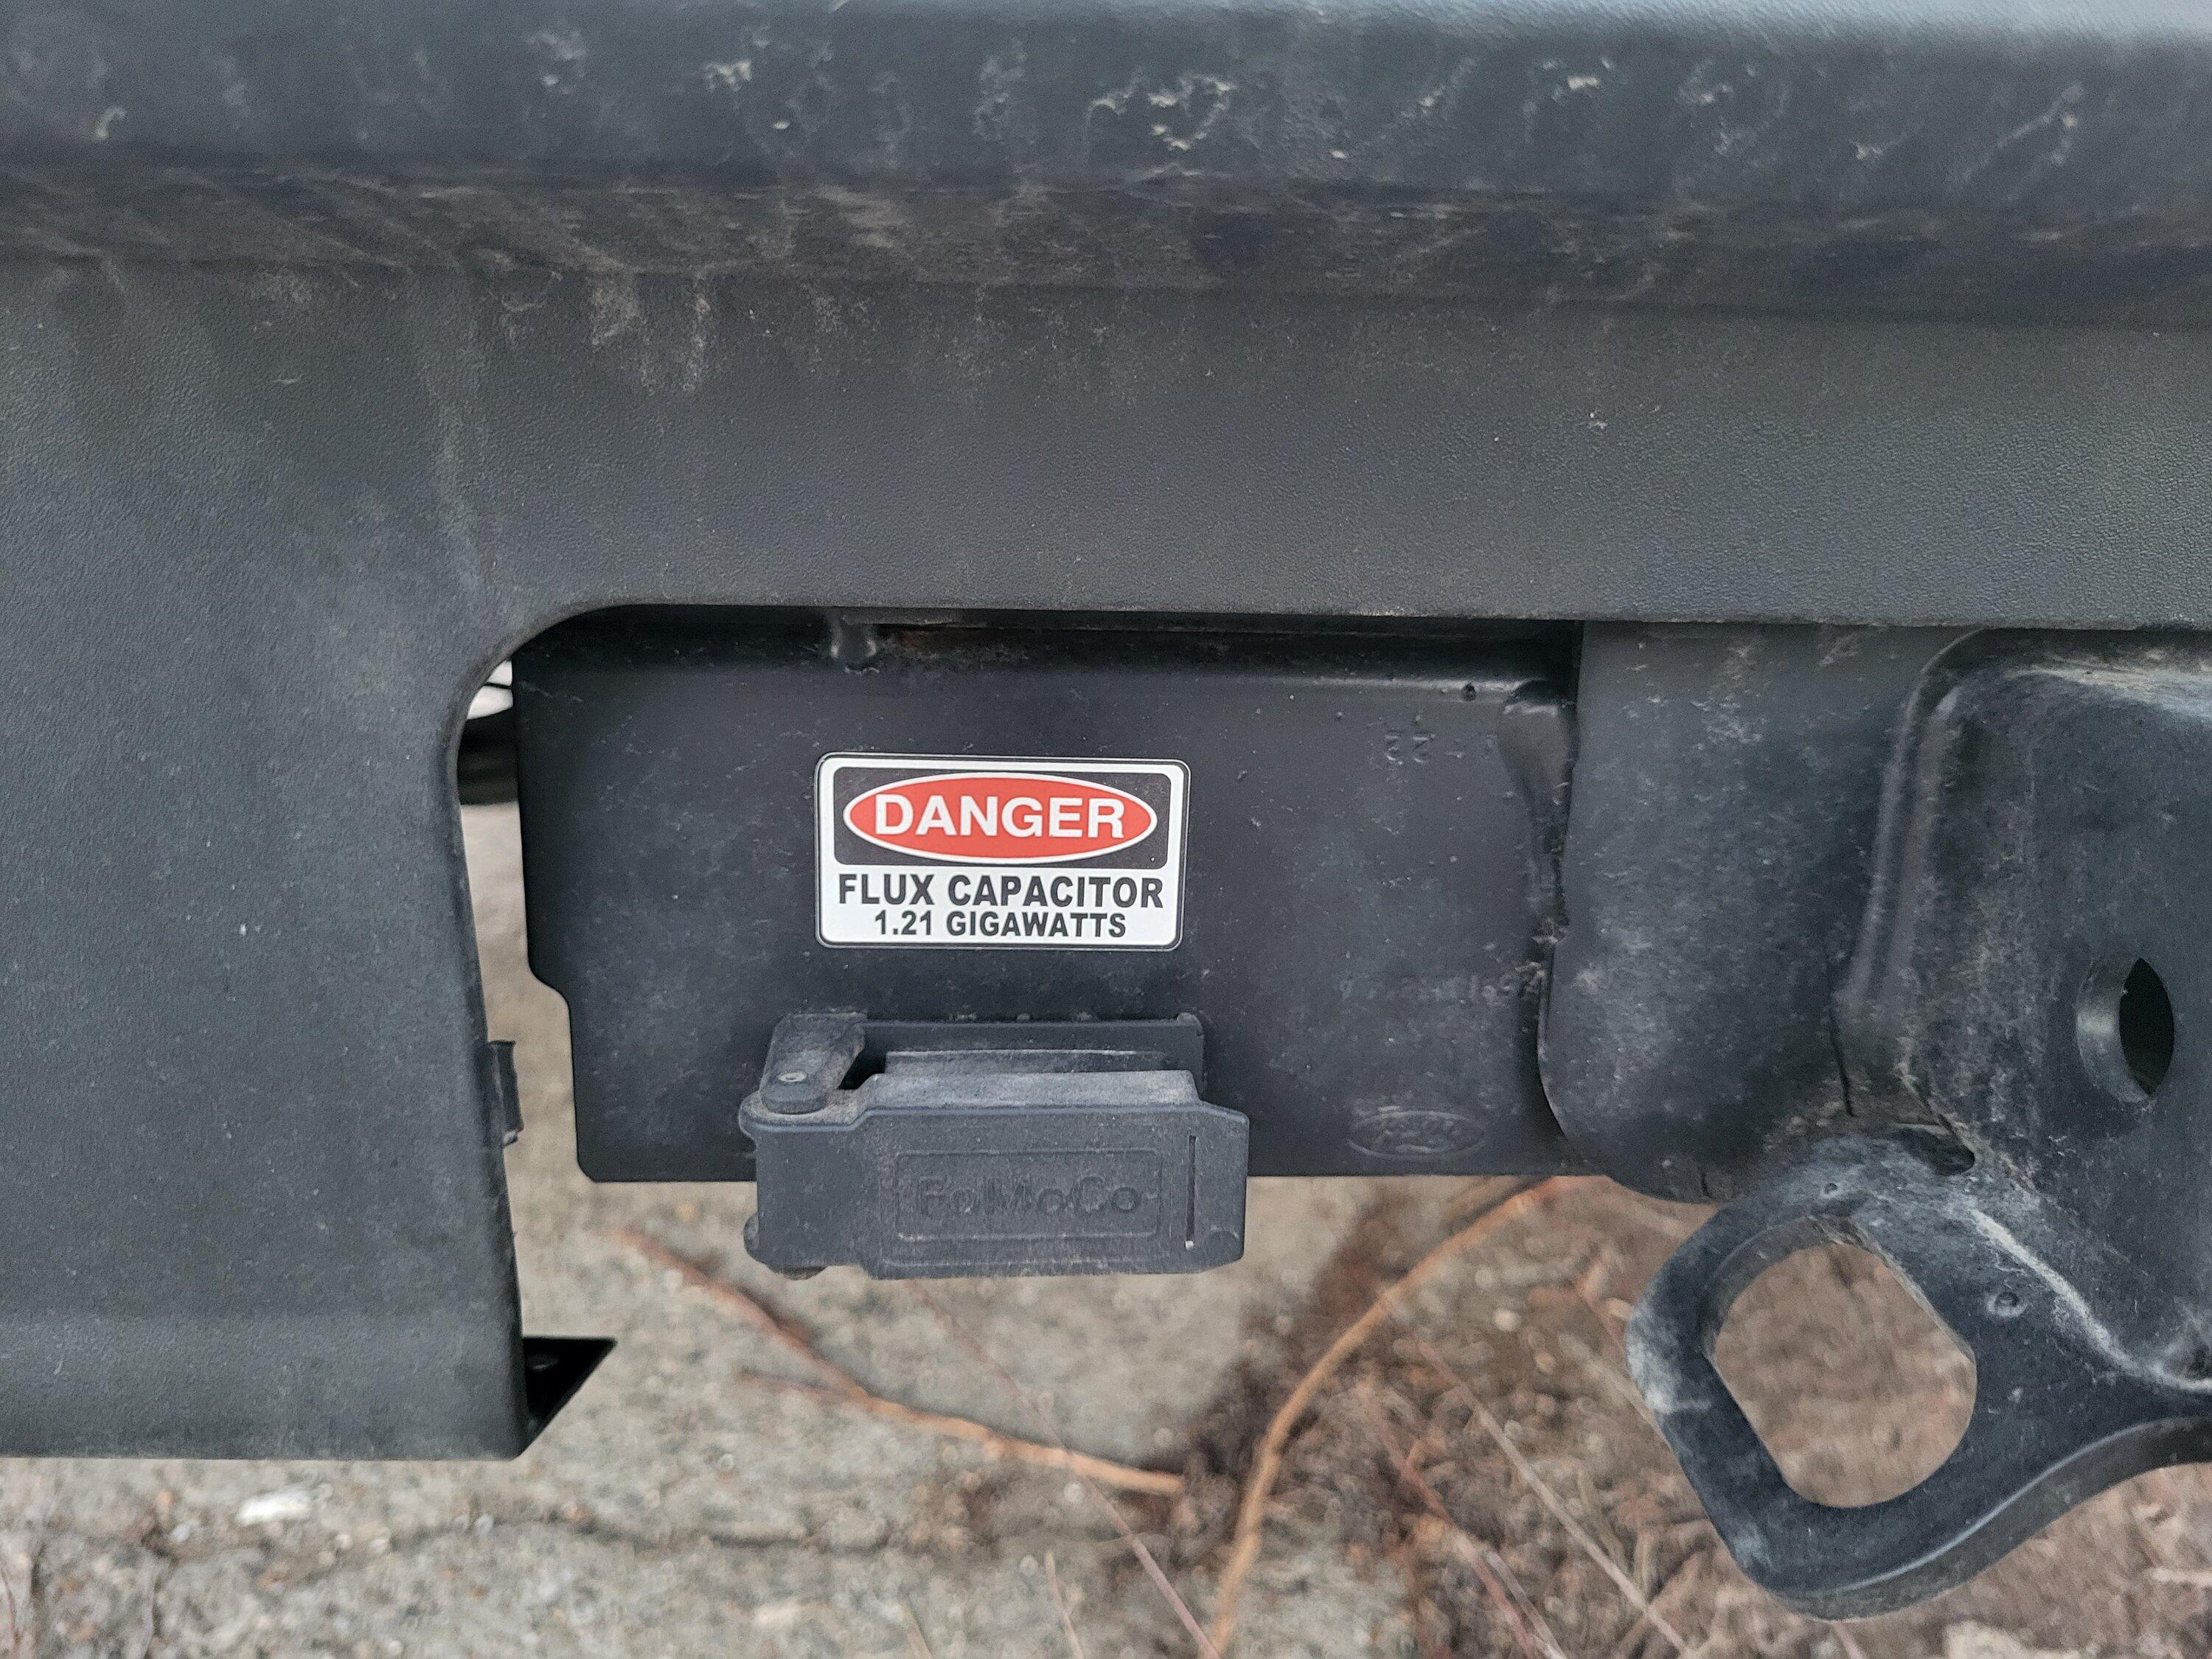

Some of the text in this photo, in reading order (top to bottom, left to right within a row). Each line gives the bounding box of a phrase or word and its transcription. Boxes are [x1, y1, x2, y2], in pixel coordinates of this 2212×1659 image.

[874, 794, 1125, 840] DANGER
[839, 874, 1164, 908] FLUX CAPACITOR
[875, 910, 1127, 939] 1.21 GIGAWATTS
[917, 1174, 1142, 1217] FoMoCo
